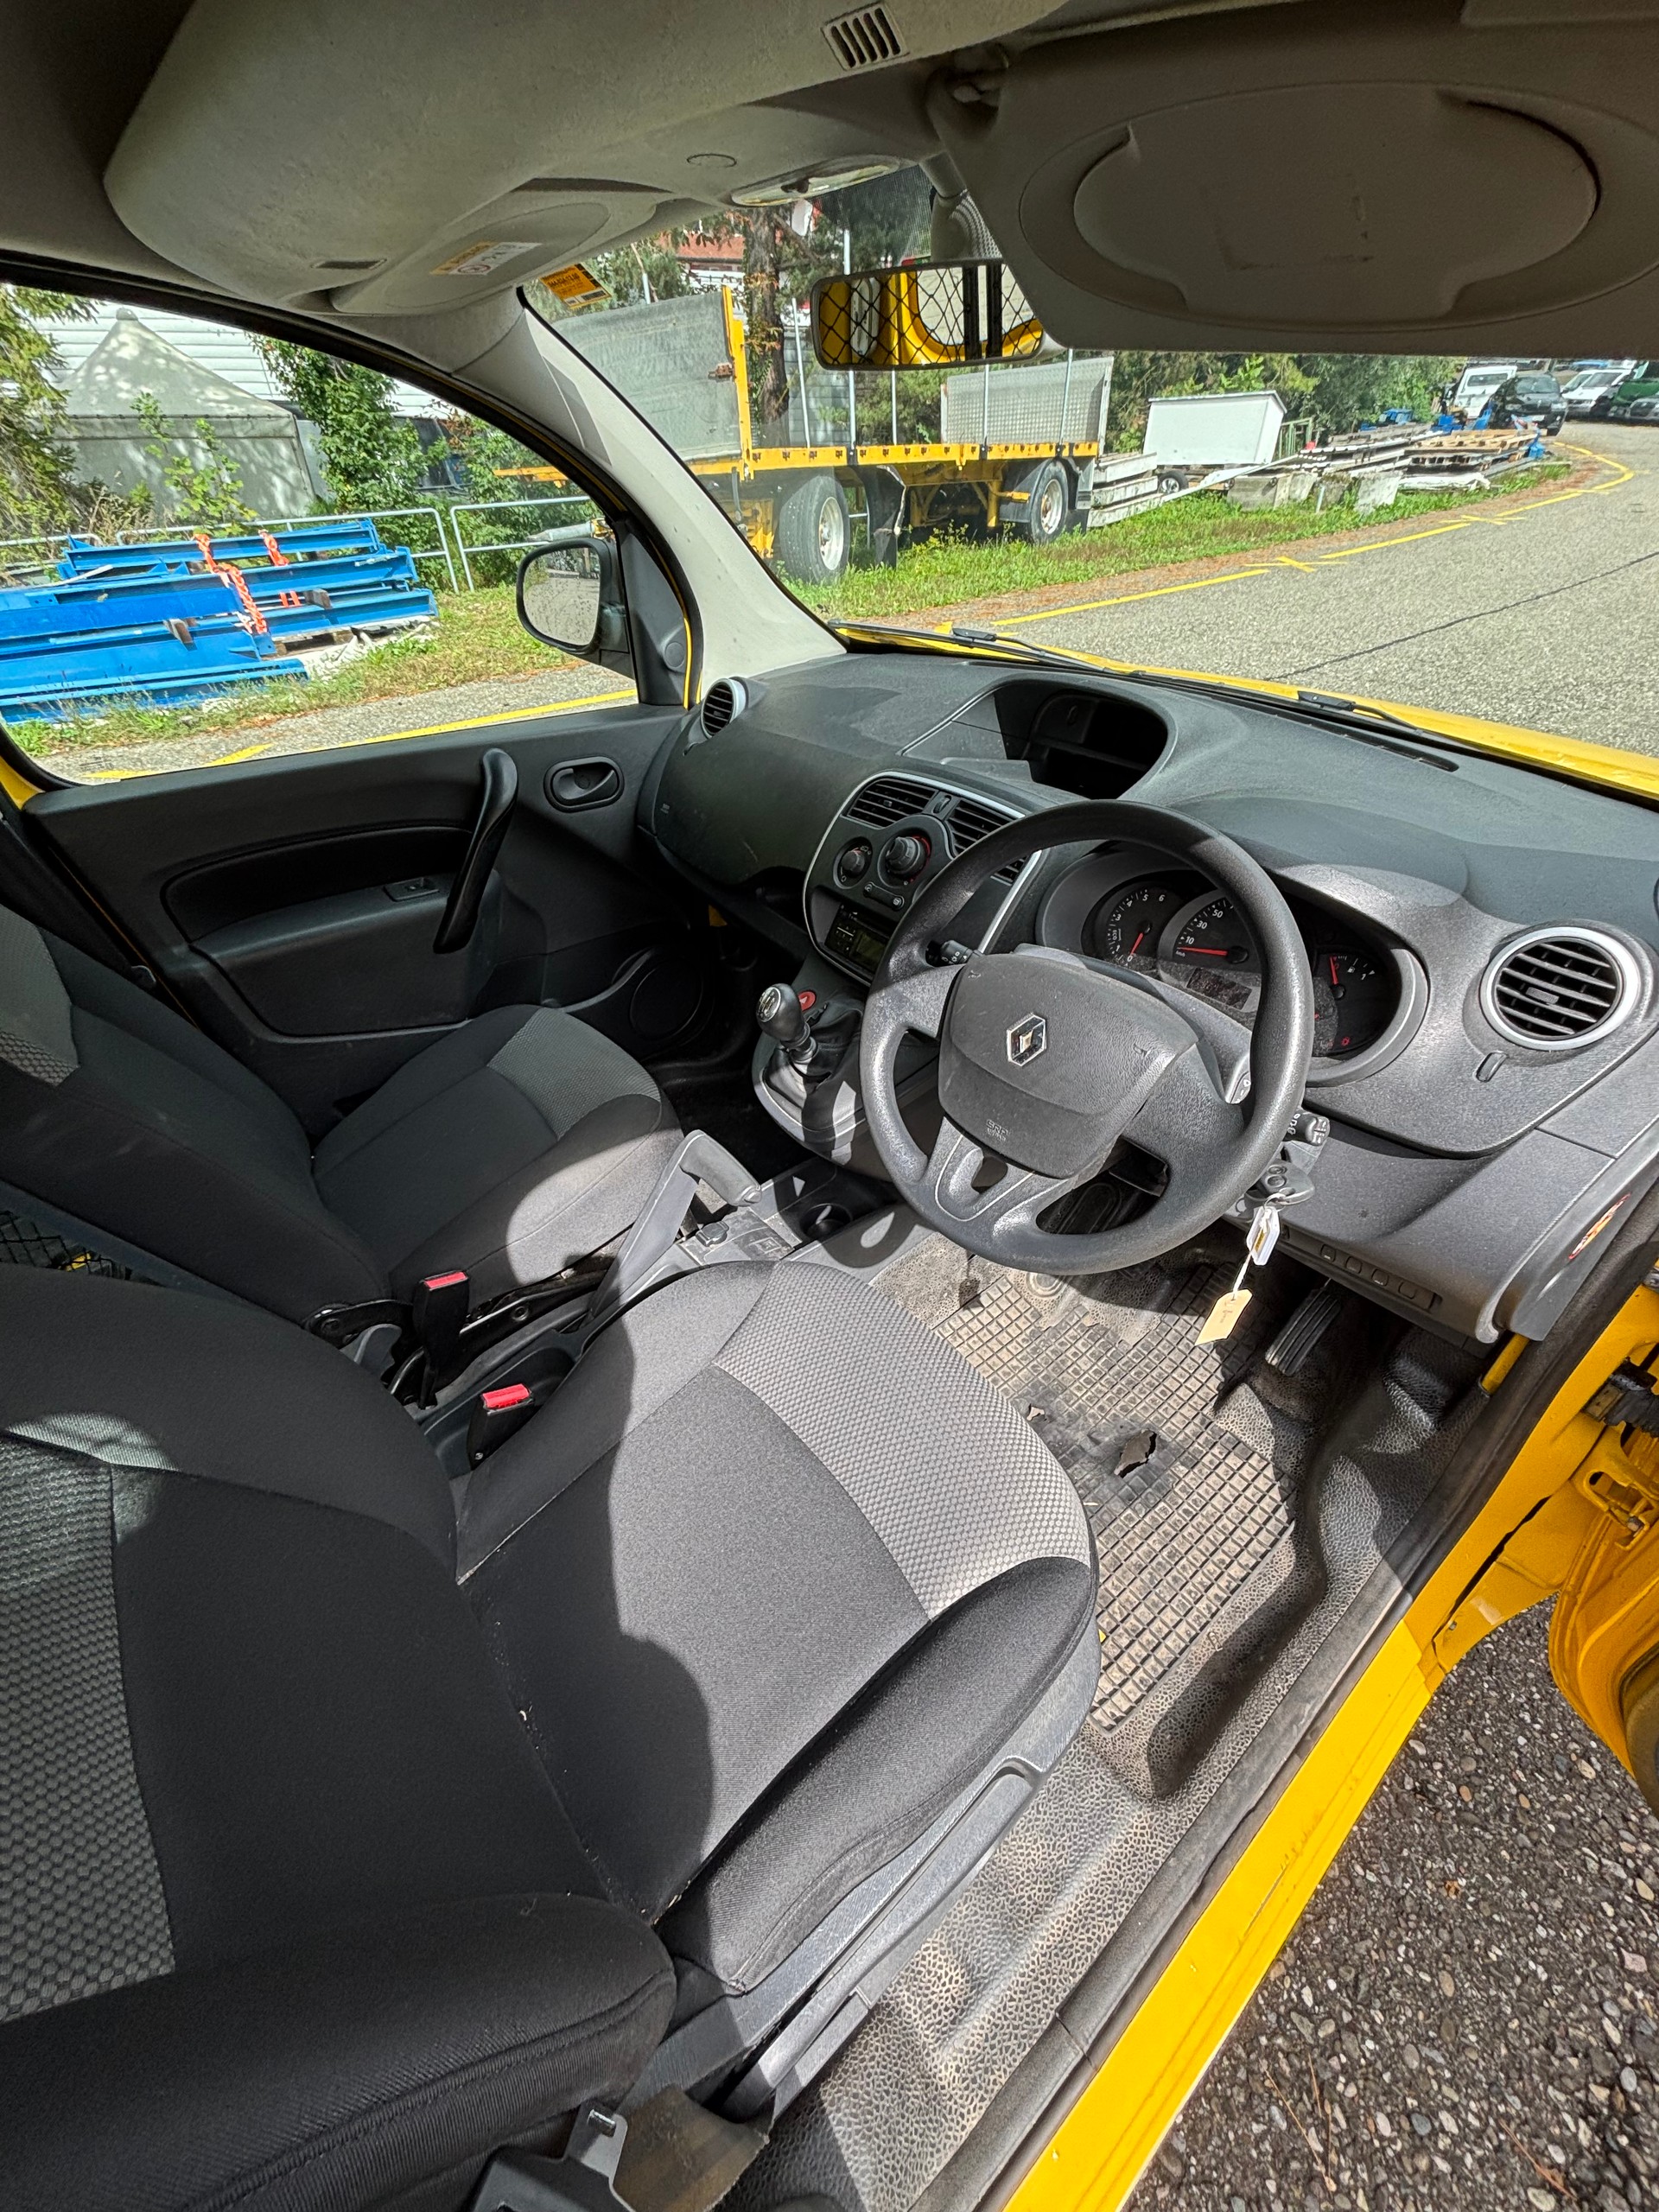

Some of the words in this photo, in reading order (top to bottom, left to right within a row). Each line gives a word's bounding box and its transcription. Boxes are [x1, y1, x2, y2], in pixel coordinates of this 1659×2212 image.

[1212, 909, 1224, 918] 50
[1197, 920, 1208, 930] 30
[1185, 936, 1195, 944] 10
